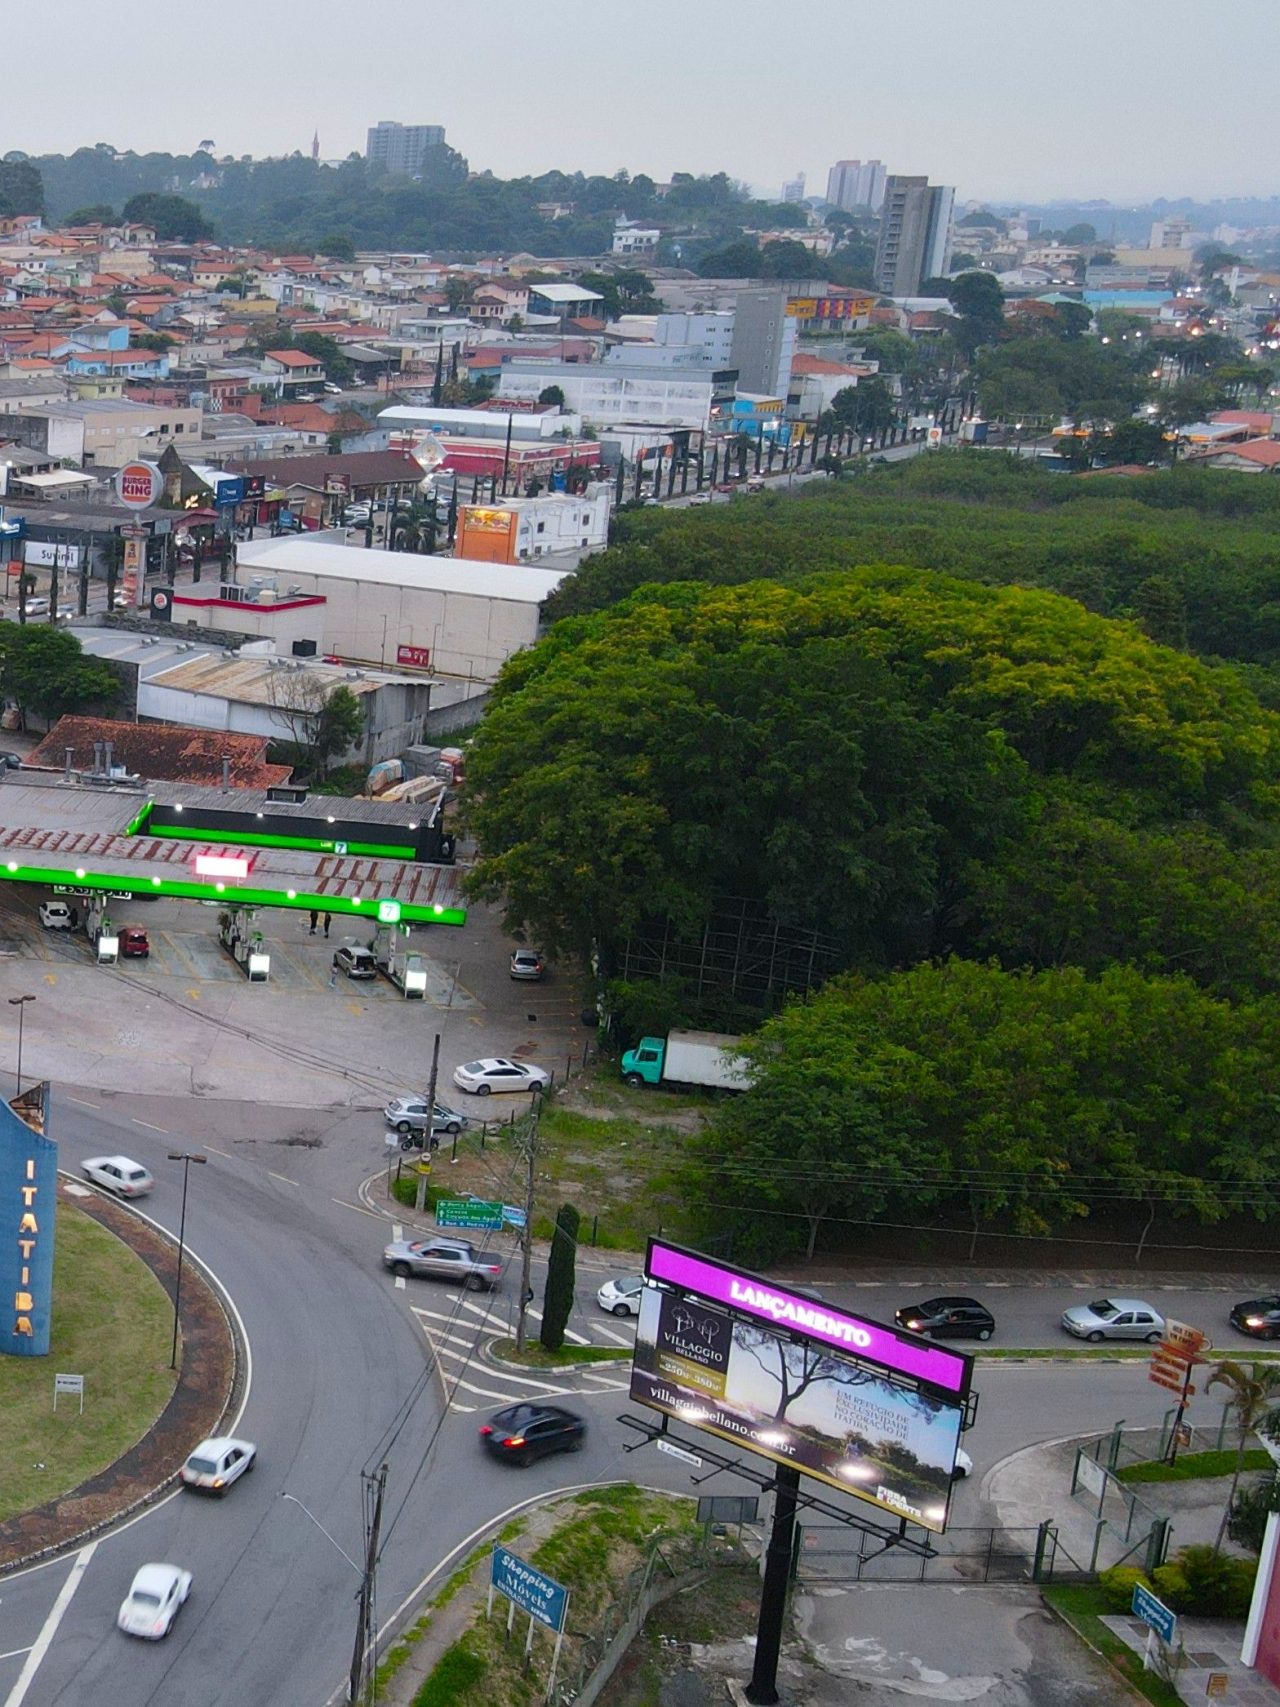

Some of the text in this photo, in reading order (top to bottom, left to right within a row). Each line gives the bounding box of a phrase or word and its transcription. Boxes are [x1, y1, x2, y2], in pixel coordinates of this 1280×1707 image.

[122, 477, 152, 486] BURGER
[122, 485, 152, 496] KING
[338, 843, 345, 853] 7
[13, 1159, 39, 1337] ITATIBA
[730, 1280, 872, 1347] LANÇAMENTO
[664, 1332, 723, 1362] VILLAGGIO
[676, 1347, 709, 1365] BELLANO
[650, 1387, 797, 1456] villaggiobellano.co.br
[834, 1411, 869, 1432] ITATIBA
[835, 1405, 908, 1441] NO CORAÇÃO DE
[836, 1397, 909, 1432] EXCLUSIVIDADE
[837, 1389, 852, 1402] UM
[896, 1413, 909, 1425] DE
[497, 1578, 527, 1608] ENTRADA
[501, 1555, 555, 1599] Shopping
[506, 1574, 548, 1610] Móveis
